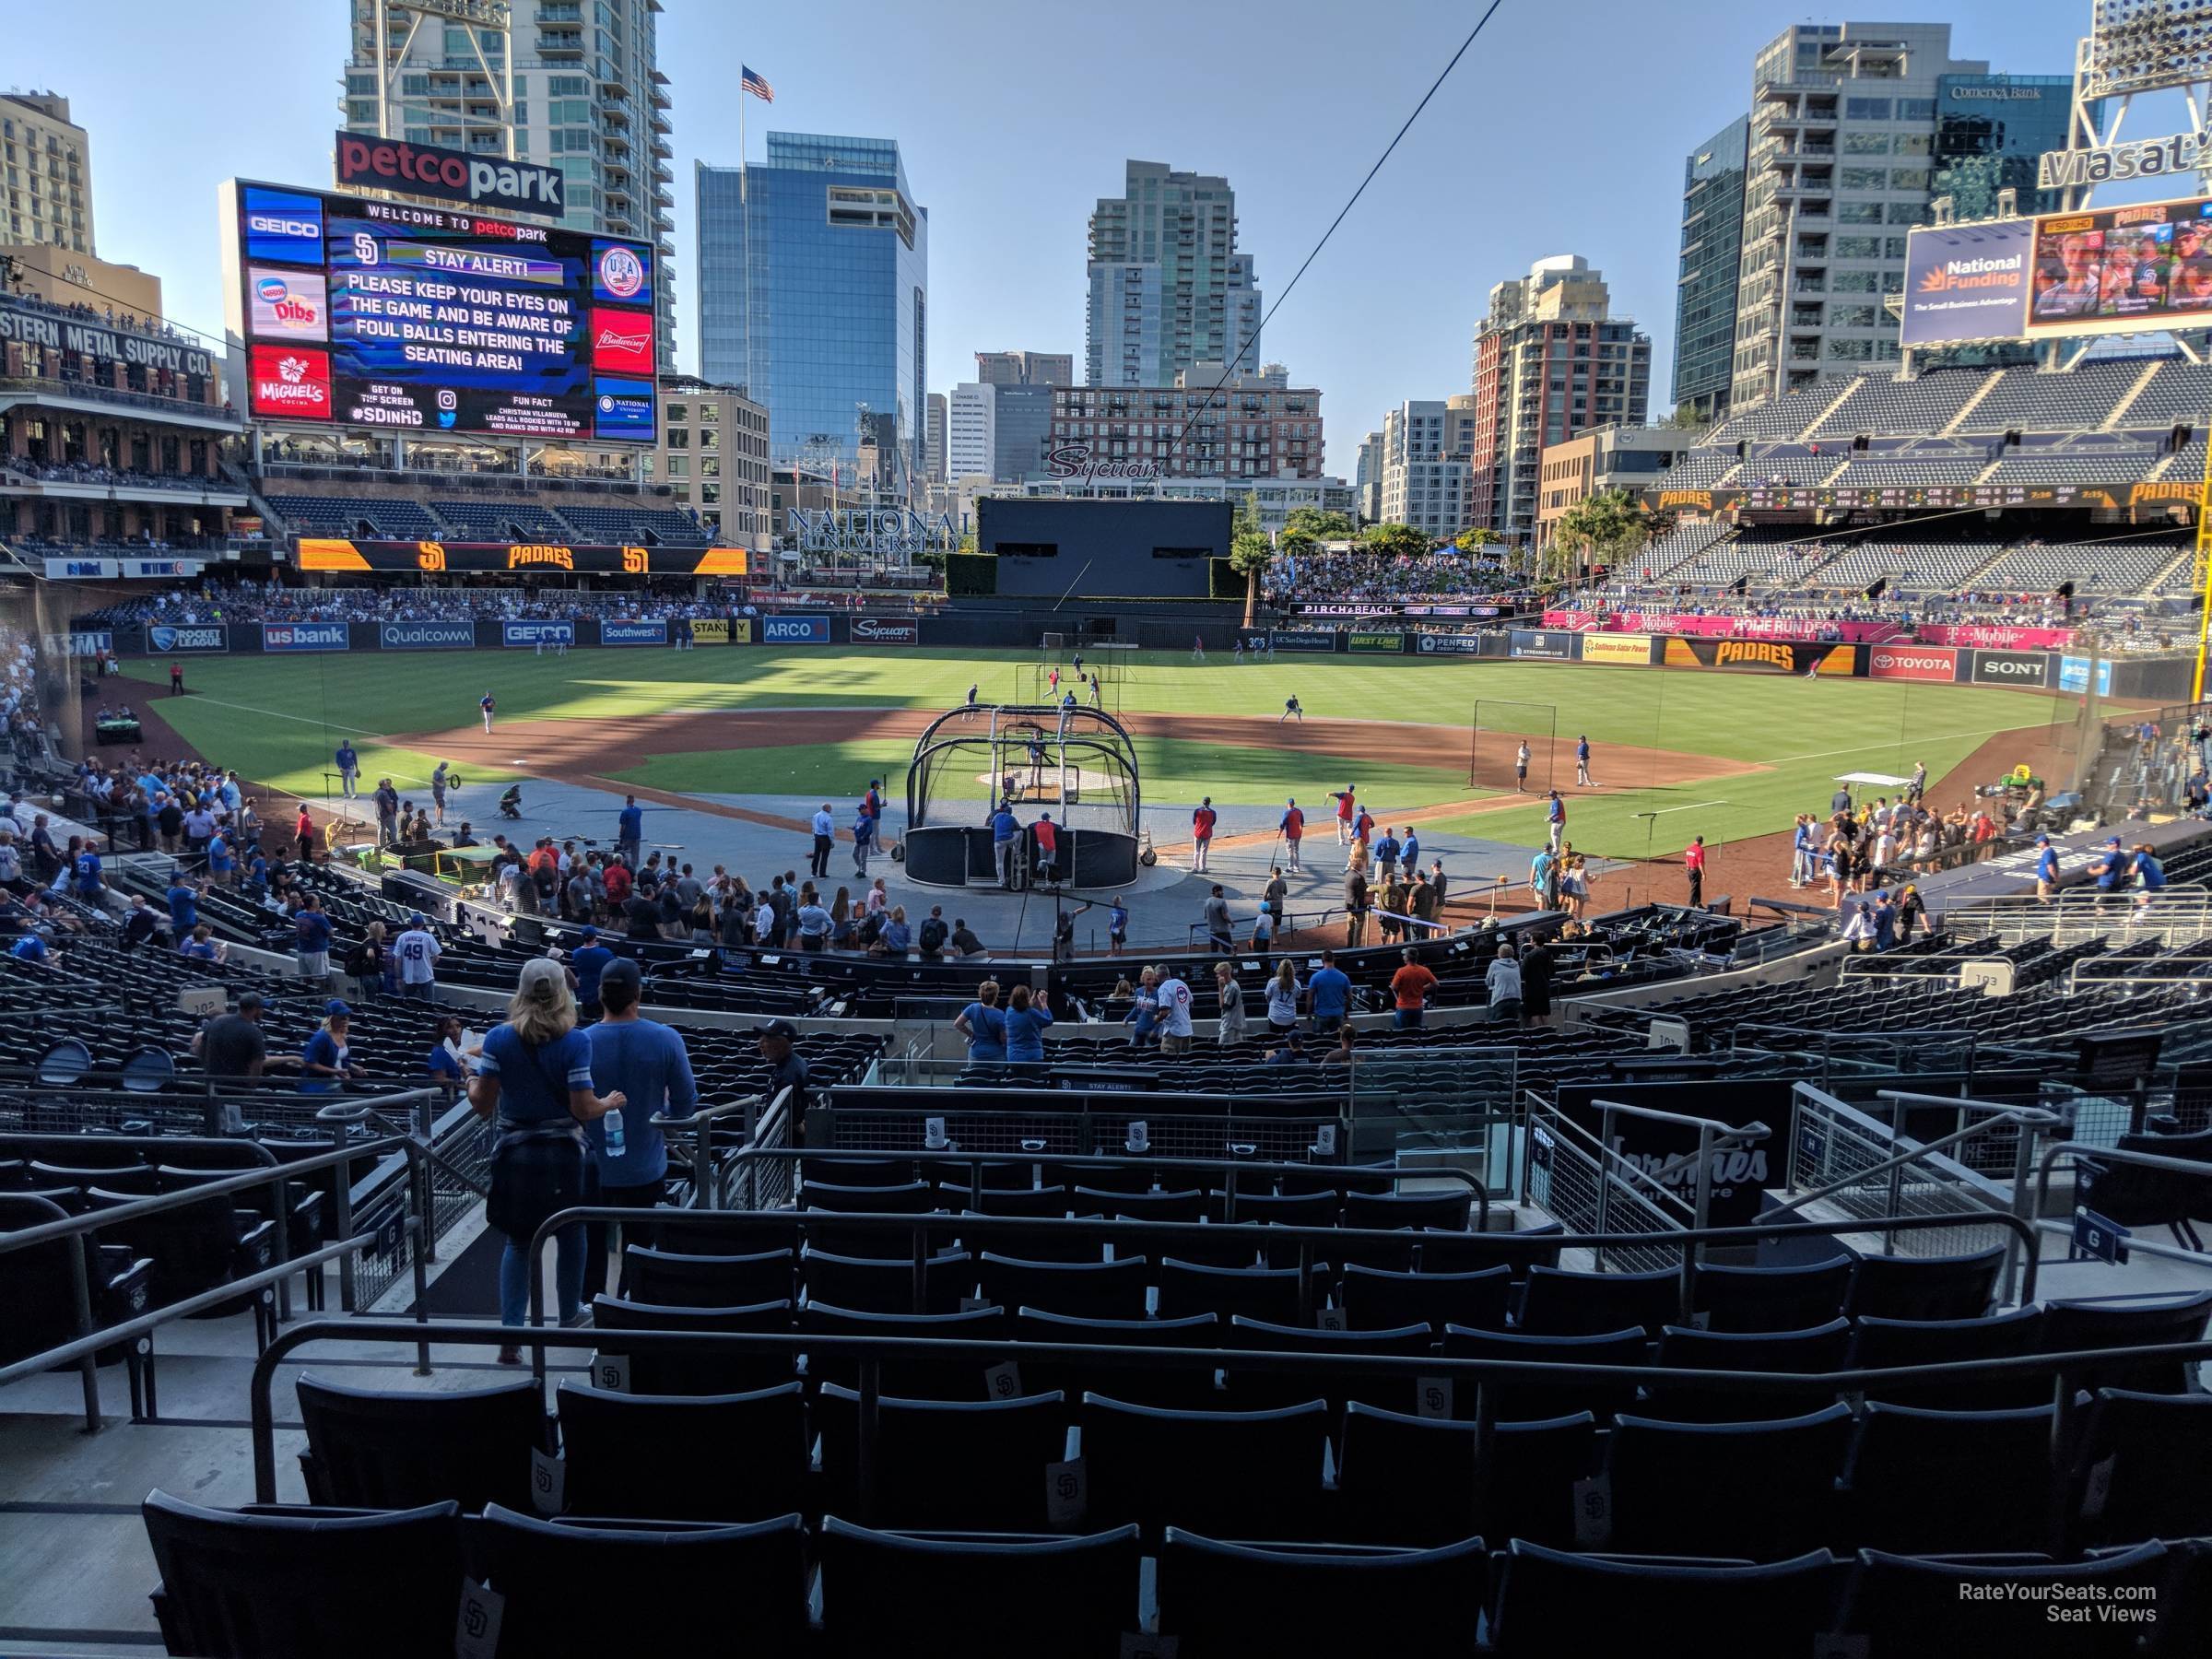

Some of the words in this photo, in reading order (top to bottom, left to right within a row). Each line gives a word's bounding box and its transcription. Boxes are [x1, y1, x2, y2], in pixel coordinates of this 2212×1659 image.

[2011, 87, 2041, 99] Bank
[2046, 135, 2192, 186] Viasat
[369, 205, 443, 227] WELCOME
[452, 218, 469, 229] TO
[251, 217, 319, 238] GEICO
[425, 250, 465, 267] STAY
[471, 256, 528, 276] ALERT!
[1947, 254, 2021, 275] National
[1946, 272, 2020, 289] Funding
[348, 274, 411, 294] PLEASE
[417, 281, 456, 297] KEEP
[459, 287, 502, 306] YOUR
[507, 293, 544, 311] EYES
[548, 299, 568, 313] ON
[275, 301, 315, 323] Dibs
[349, 296, 382, 313] THE
[386, 300, 431, 319] GAME
[436, 307, 468, 323] AND
[473, 310, 493, 325] BE
[497, 312, 549, 332] AWARE
[553, 319, 572, 335] OF
[357, 320, 399, 337] FOUL
[403, 324, 453, 343] BALLS
[458, 330, 533, 351] ENTERING
[535, 338, 564, 354] THE
[602, 335, 643, 348] Budweiser
[66, 325, 122, 359] METAL
[124, 338, 182, 371] SUPPLY
[187, 352, 211, 376] CO.
[406, 346, 473, 366] SEATING
[476, 353, 523, 371] AREA!
[371, 385, 389, 394] GET
[391, 386, 403, 394] ON
[381, 396, 414, 406] SCREEN
[513, 396, 530, 405] FUN
[532, 398, 553, 406] FACT
[616, 399, 649, 408] NATIONAL
[499, 407, 531, 417] CHRISTIAN
[532, 411, 567, 419] VILLANUEVA
[1046, 444, 1164, 488] Sycuan
[1659, 491, 1712, 510] PADRES
[2129, 483, 2204, 506] PADRES
[788, 507, 974, 535] NATIONAL
[804, 533, 962, 553] UNIVERSITY
[509, 546, 573, 570] PADRES
[1355, 606, 1393, 614] BEACH
[179, 629, 220, 639] ROCKET
[385, 627, 471, 642] Qualcomm
[606, 627, 656, 638] Southwest
[694, 622, 746, 633] STANLY
[767, 623, 811, 637] ARCO
[855, 619, 912, 640] Sycuan
[1774, 619, 1803, 632] RUN
[1804, 620, 1840, 633] DECK
[179, 638, 221, 647] LEAGUE
[1351, 636, 1376, 644] WEST
[1377, 637, 1402, 645] LAKE
[1437, 638, 1475, 647] PENFED
[1715, 641, 1794, 671] PADRES
[1896, 657, 1951, 671] TOYOTA
[1985, 661, 2043, 676] SONY
[404, 944, 423, 960] 49
[388, 1225, 396, 1244] G
[2088, 1230, 2101, 1249] G
